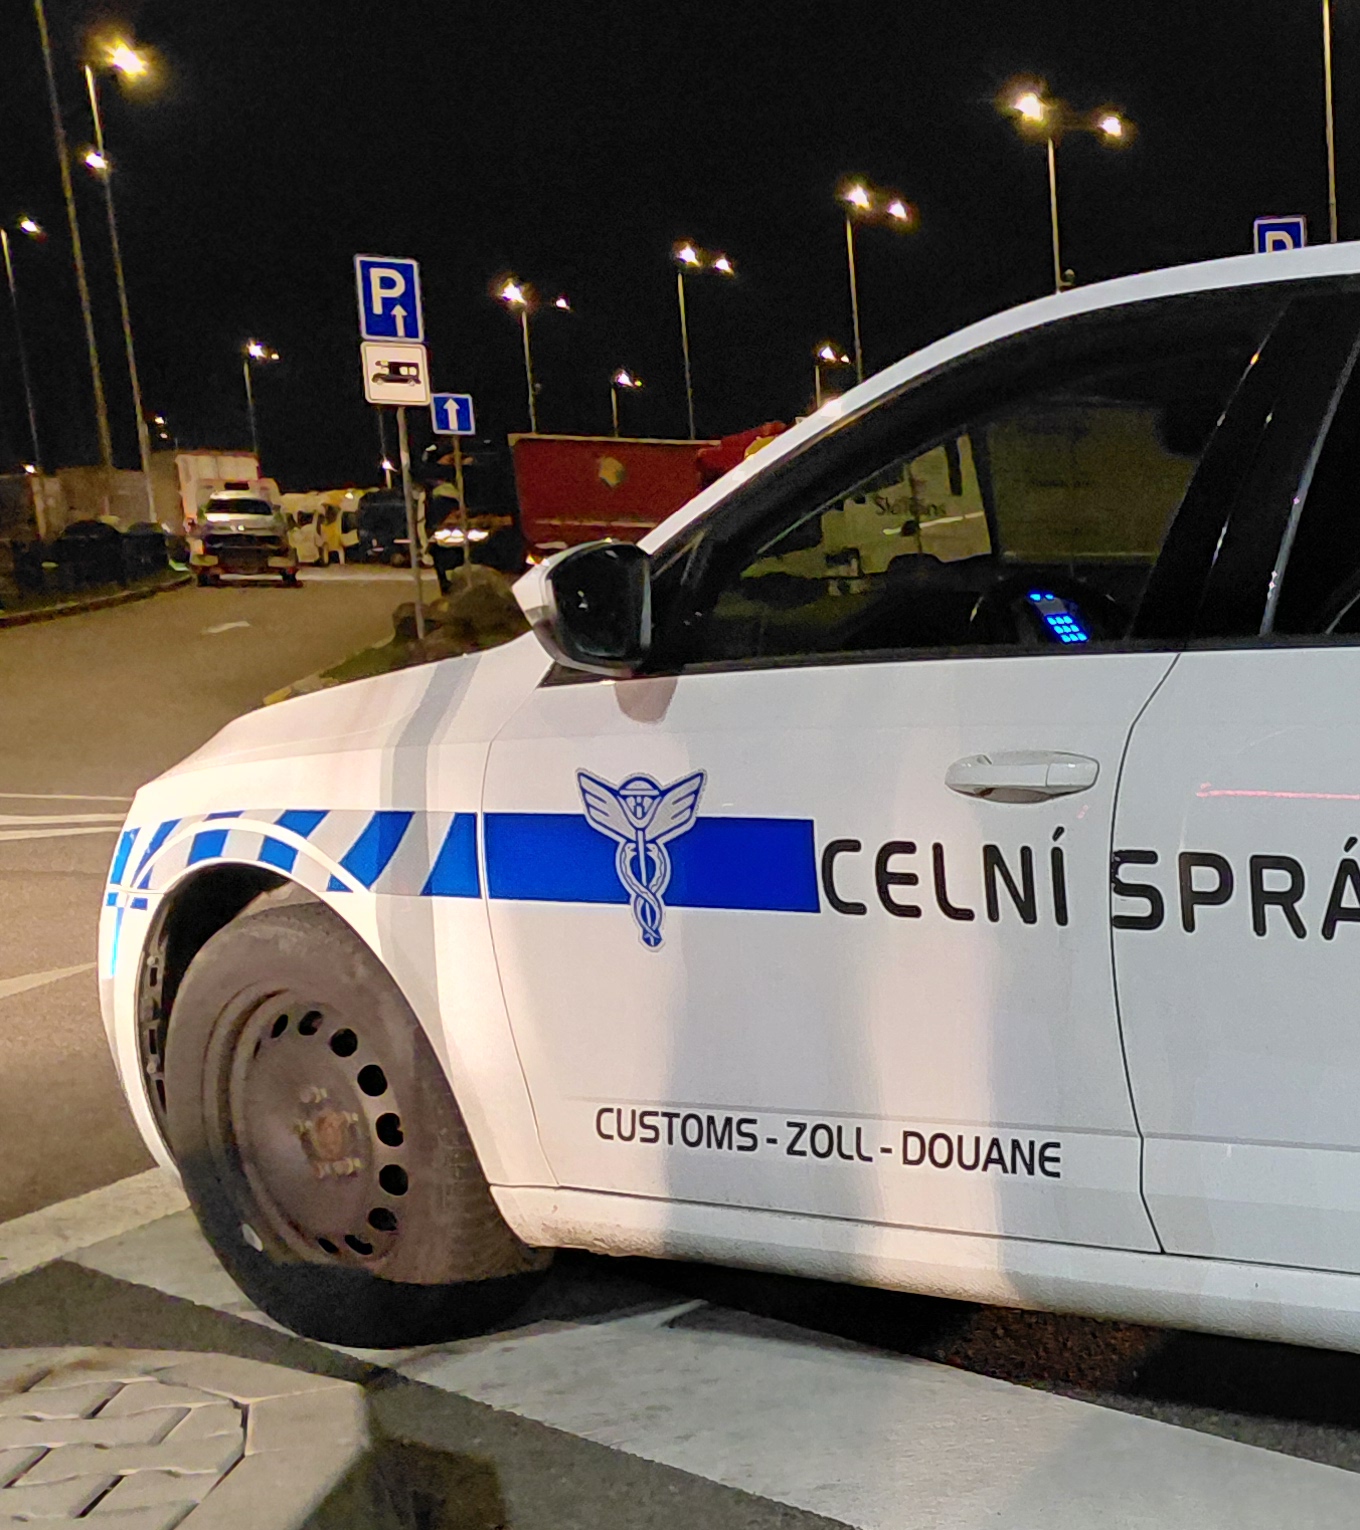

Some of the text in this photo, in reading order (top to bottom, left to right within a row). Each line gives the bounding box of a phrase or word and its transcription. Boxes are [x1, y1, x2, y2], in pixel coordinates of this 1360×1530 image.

[369, 266, 406, 315] P
[819, 826, 1070, 928] CELNÍ
[595, 1106, 759, 1153] CUSTOMS
[786, 1120, 874, 1163] ZOLL
[902, 1129, 1062, 1180] DOUANE
